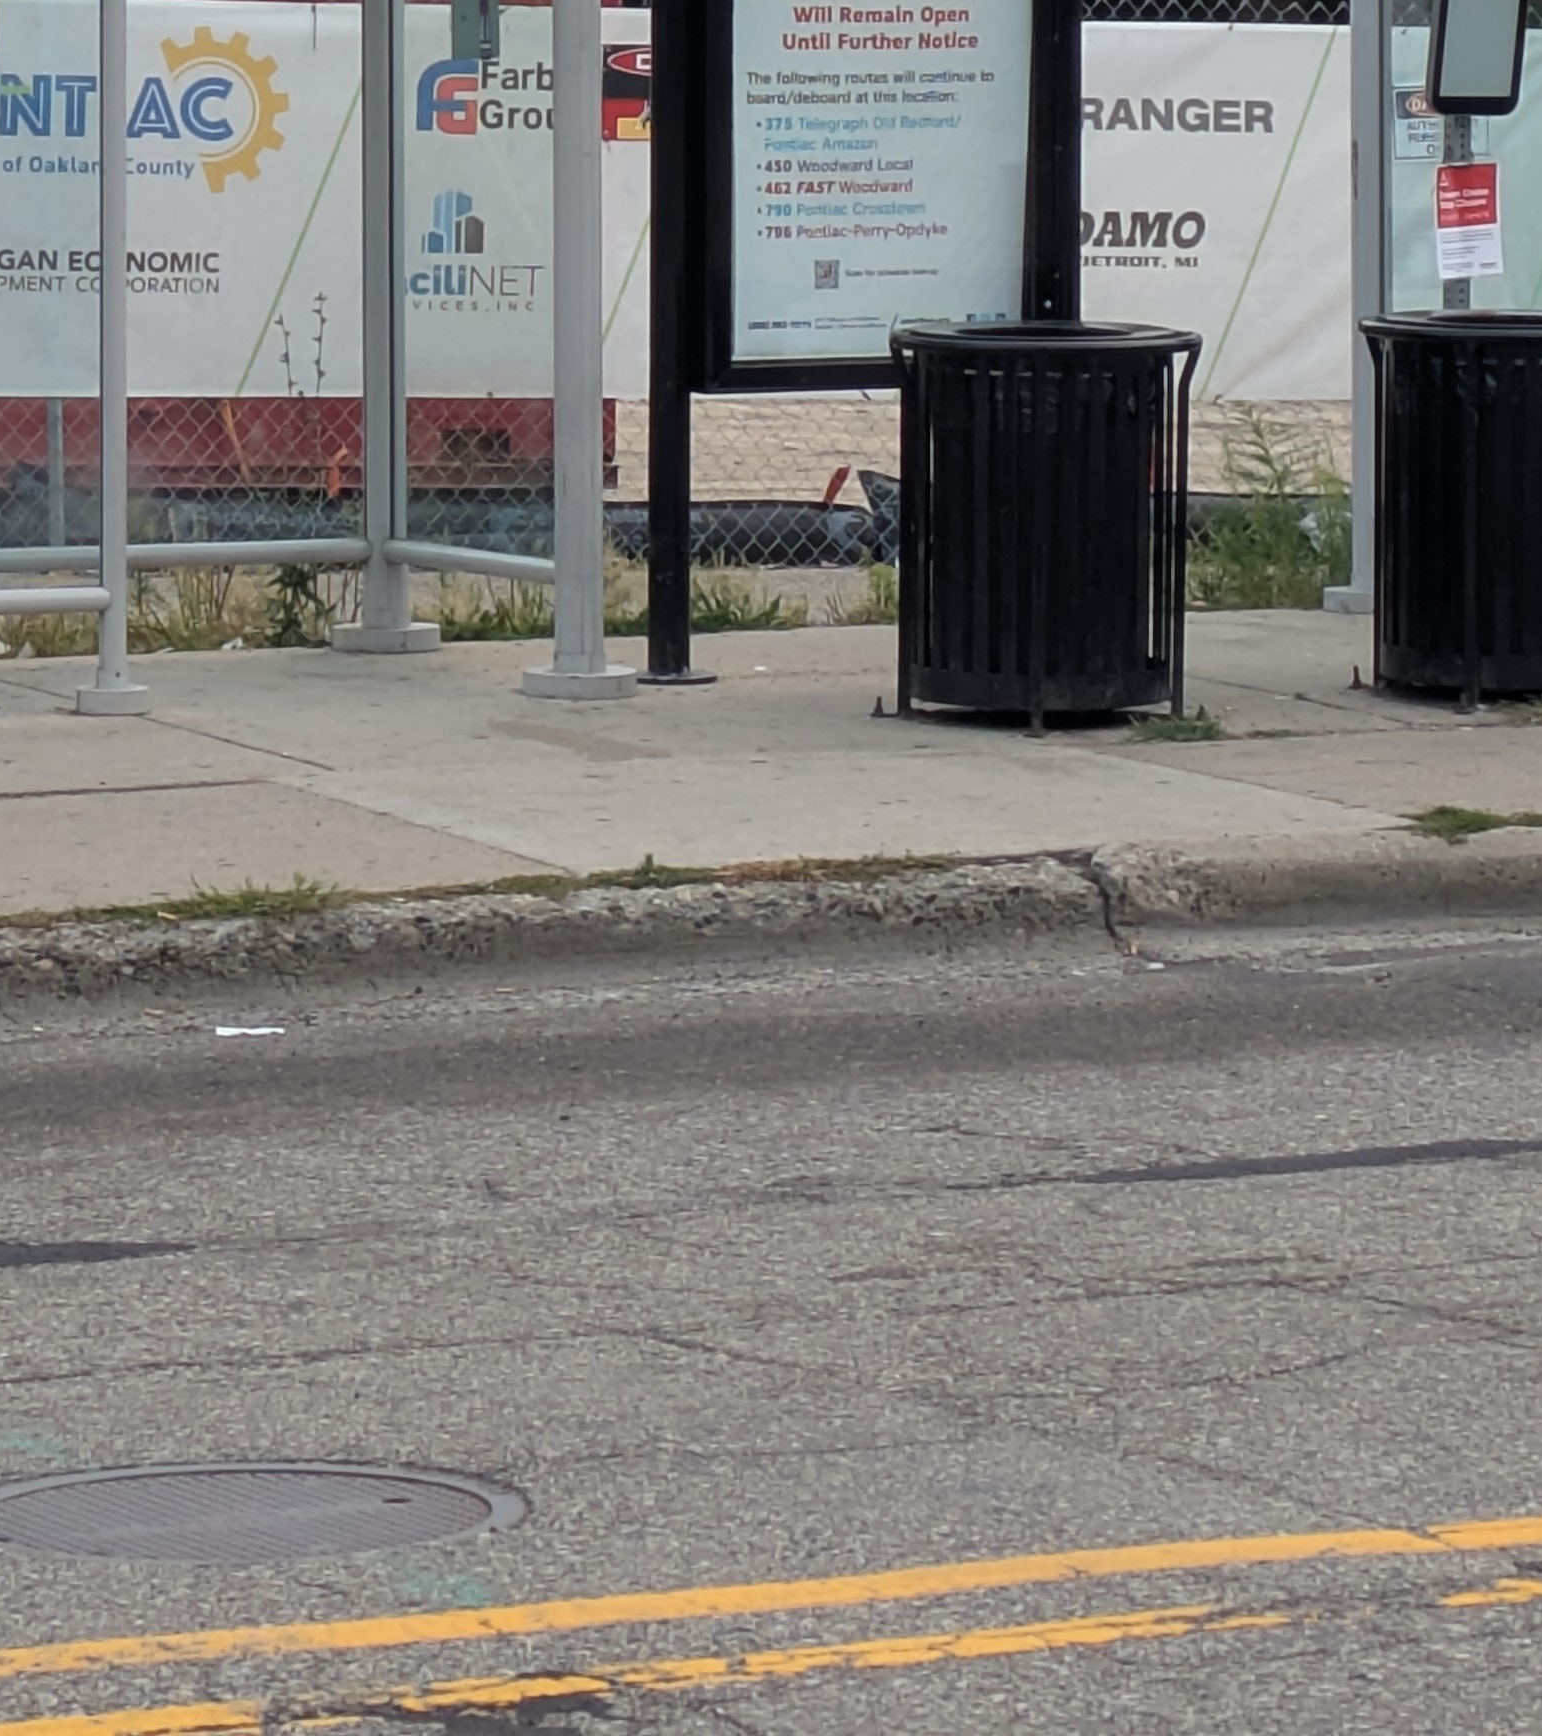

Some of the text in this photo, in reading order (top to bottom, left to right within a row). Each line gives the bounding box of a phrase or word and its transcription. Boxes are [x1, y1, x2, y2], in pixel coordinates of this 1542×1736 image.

[793, 5, 970, 26] Will Remain Open
[782, 30, 979, 50] Until Further Notice
[747, 72, 772, 85] The
[776, 71, 840, 87] following
[845, 73, 889, 85] routes
[893, 71, 916, 84] will
[1080, 97, 1274, 134] RANGER
[2, 155, 22, 173] of
[30, 155, 101, 174] Oaklan
[797, 159, 873, 172] Woodward
[796, 180, 837, 195] FAST
[68, 251, 220, 275] ECNOMIC
[1174, 256, 1199, 268] MI
[75, 276, 220, 295] COORATION
[404, 264, 545, 298] ciliNET
